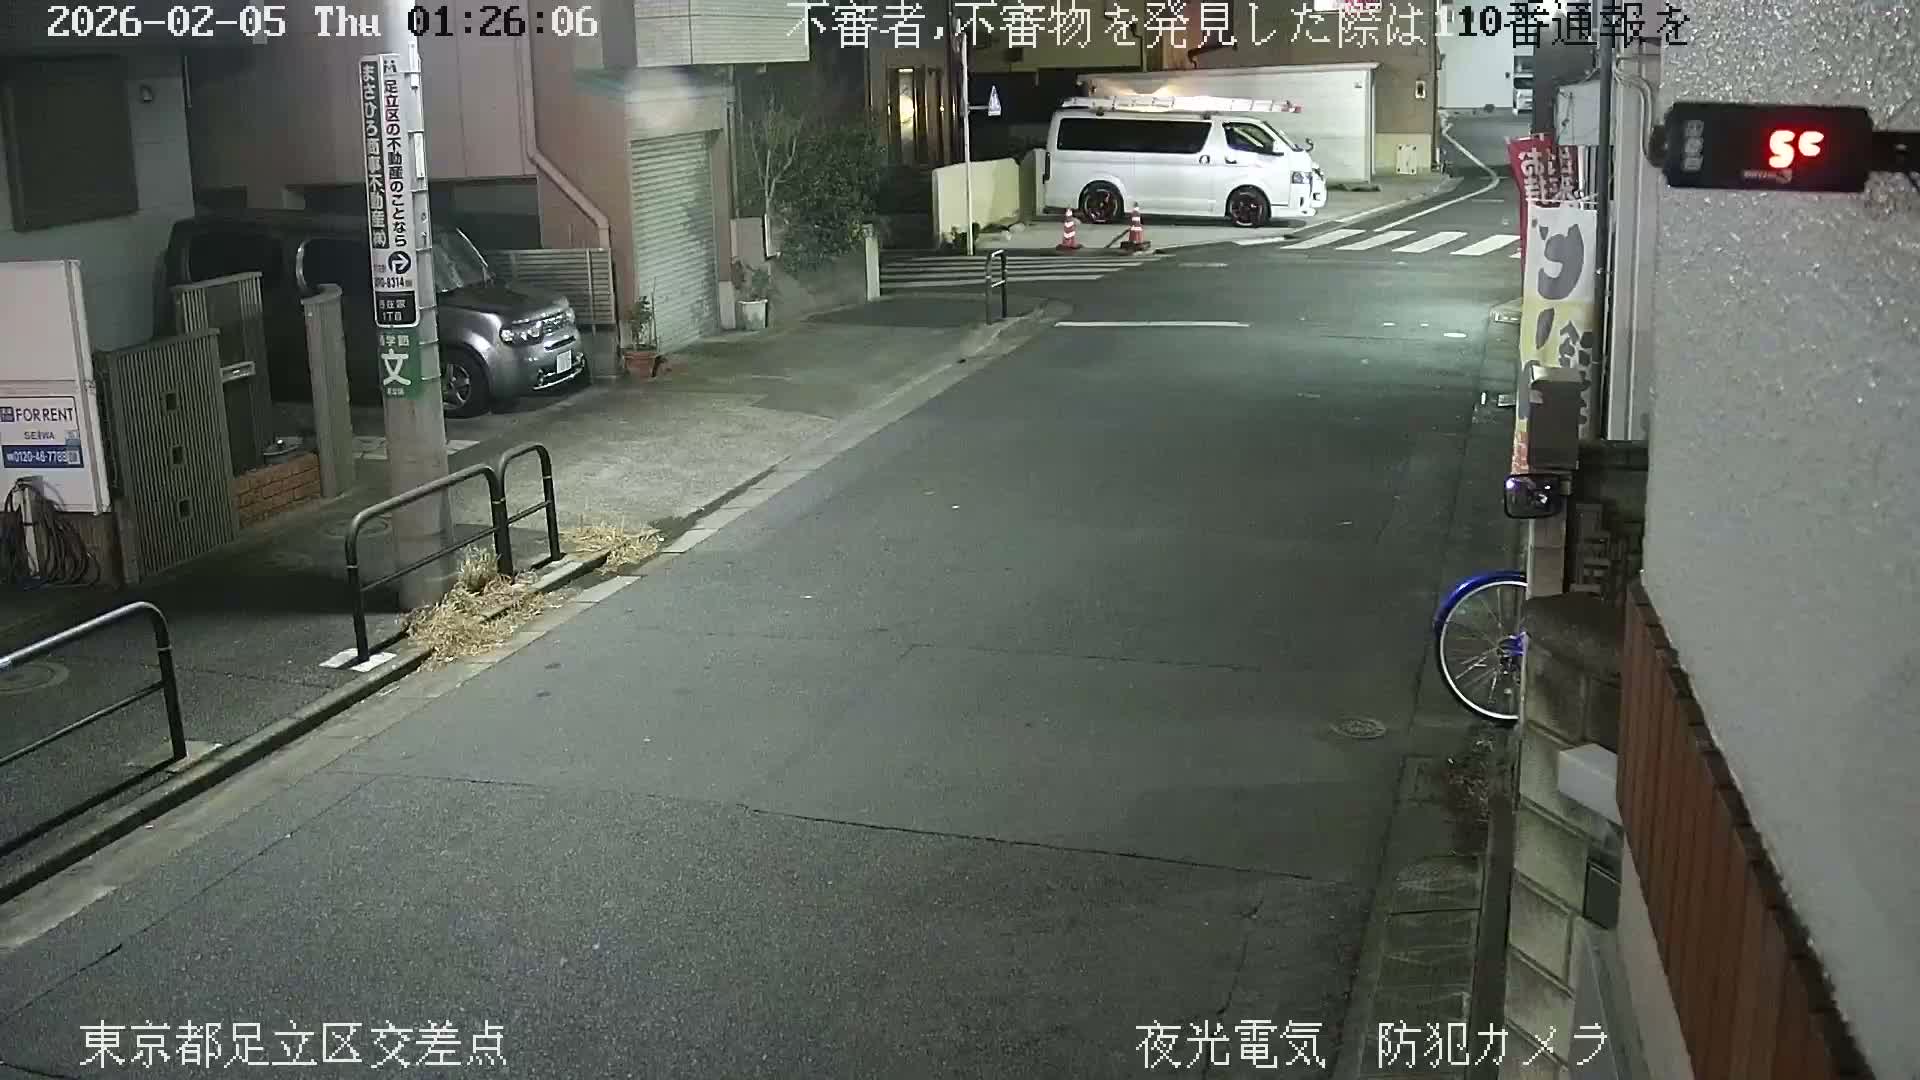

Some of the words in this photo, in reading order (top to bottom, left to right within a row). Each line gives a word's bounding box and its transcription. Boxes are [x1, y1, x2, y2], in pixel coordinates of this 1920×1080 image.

[384, 80, 408, 248] 足立区の不動産のことなら
[380, 348, 412, 386] 文
[15, 407, 41, 422] FOR
[42, 407, 73, 422] RENT
